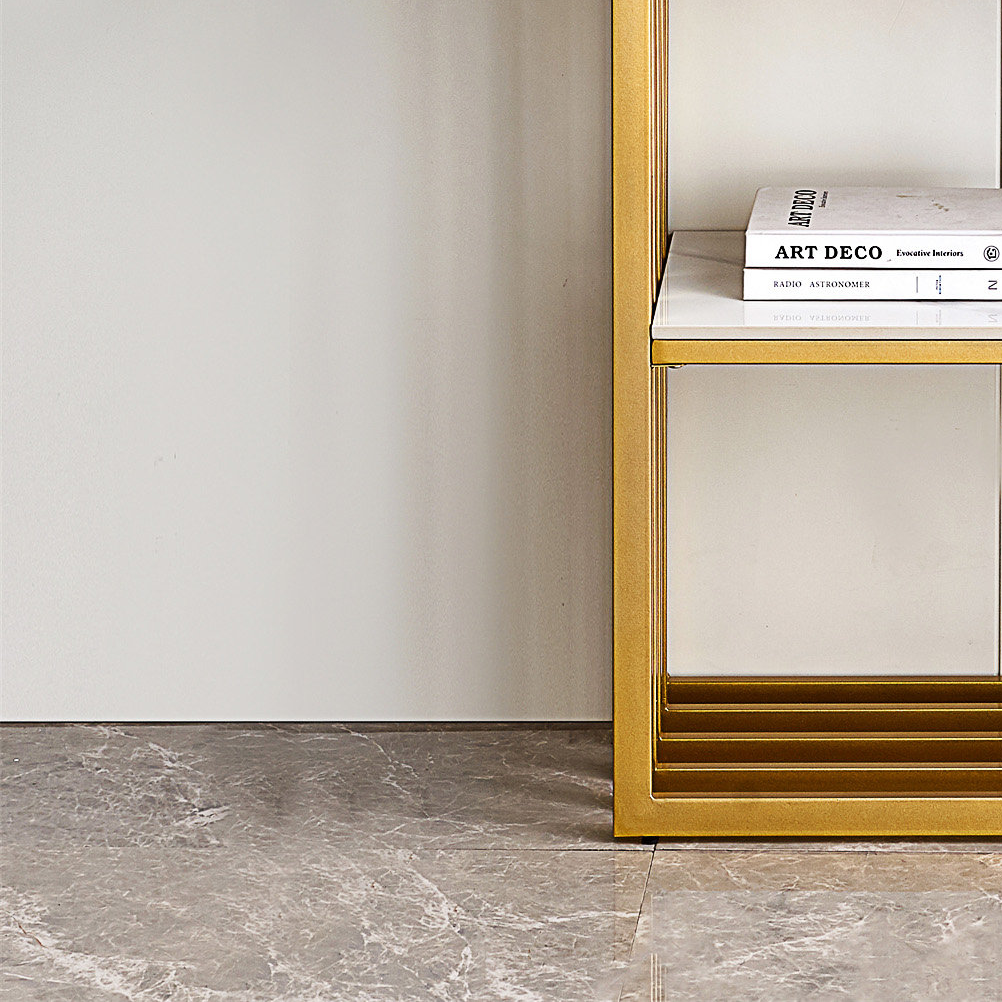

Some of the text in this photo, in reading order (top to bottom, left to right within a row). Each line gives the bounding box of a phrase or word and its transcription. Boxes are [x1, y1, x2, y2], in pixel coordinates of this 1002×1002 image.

[787, 189, 817, 228] ART DECO
[774, 245, 883, 260] ART DECO
[896, 249, 964, 257] Evocative Interiors
[773, 280, 870, 288] RADIO ASTRONOMER
